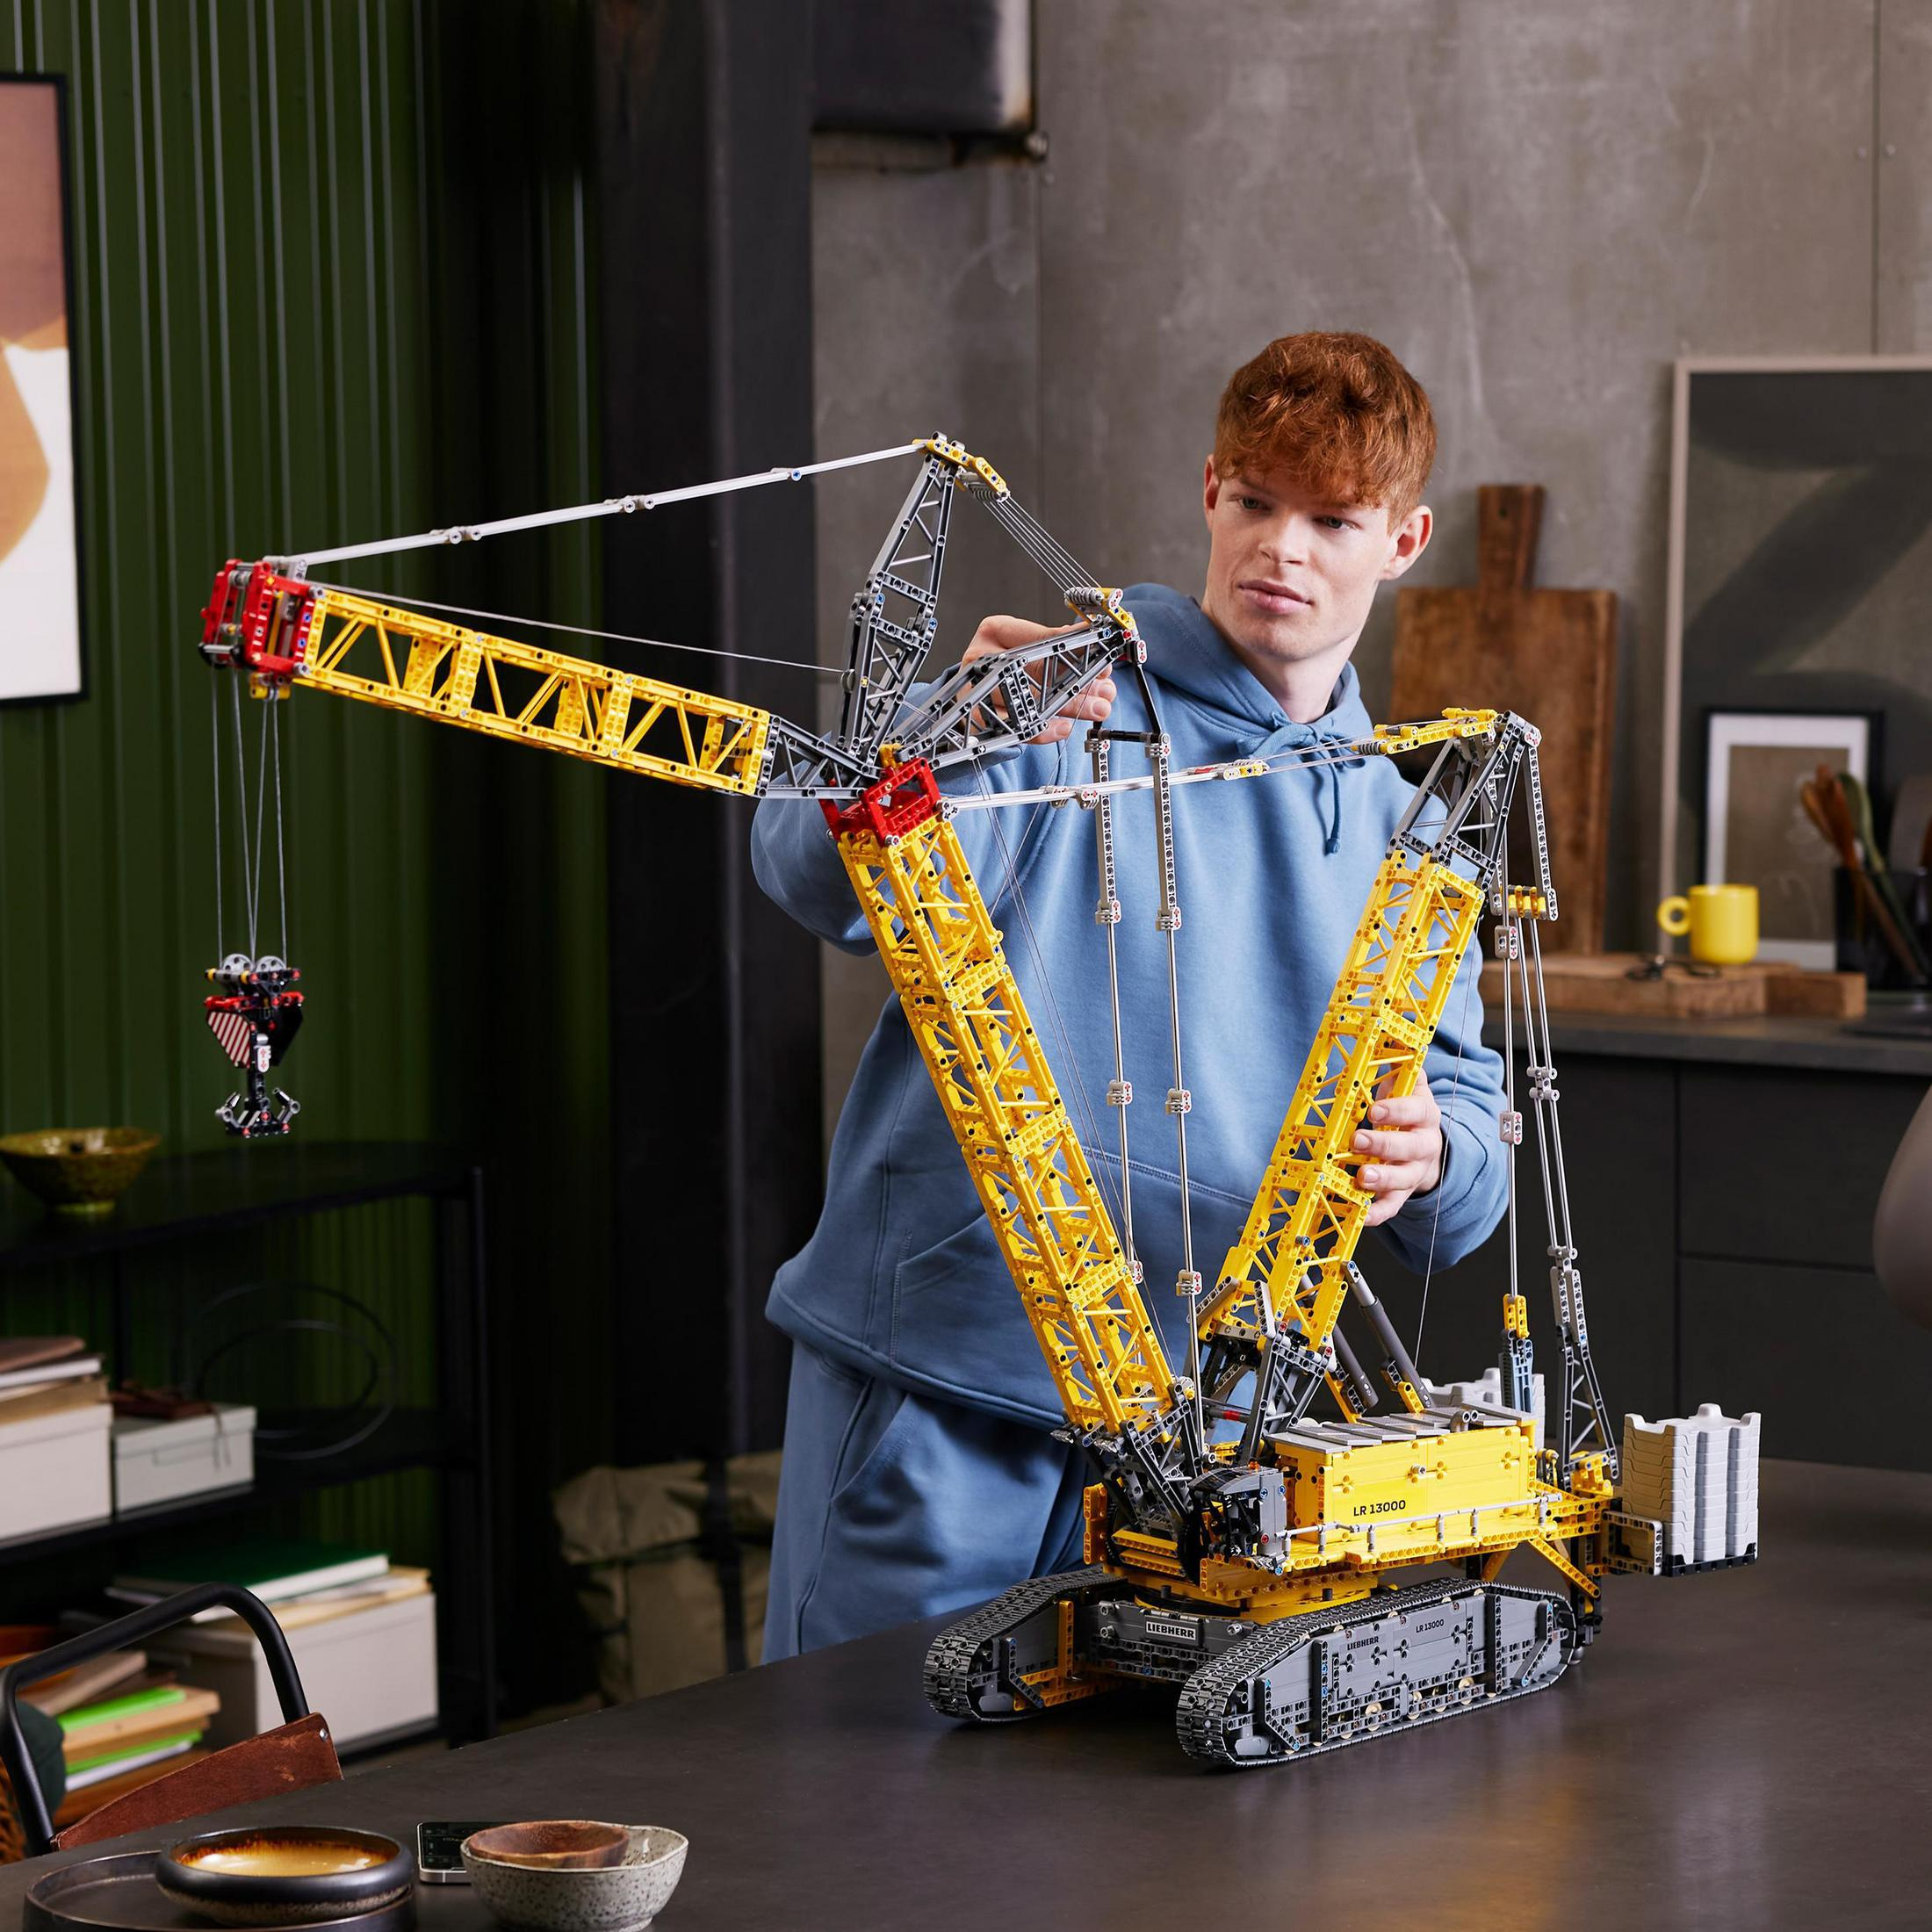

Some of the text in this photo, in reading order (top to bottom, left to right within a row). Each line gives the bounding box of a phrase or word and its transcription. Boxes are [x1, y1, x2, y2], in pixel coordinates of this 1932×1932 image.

[1353, 1500, 1406, 1517] LR 13000
[1147, 1623, 1195, 1639] LIEBHERR
[1416, 1618, 1445, 1633] LR 13000
[1347, 1636, 1379, 1650] LIEBHERR
